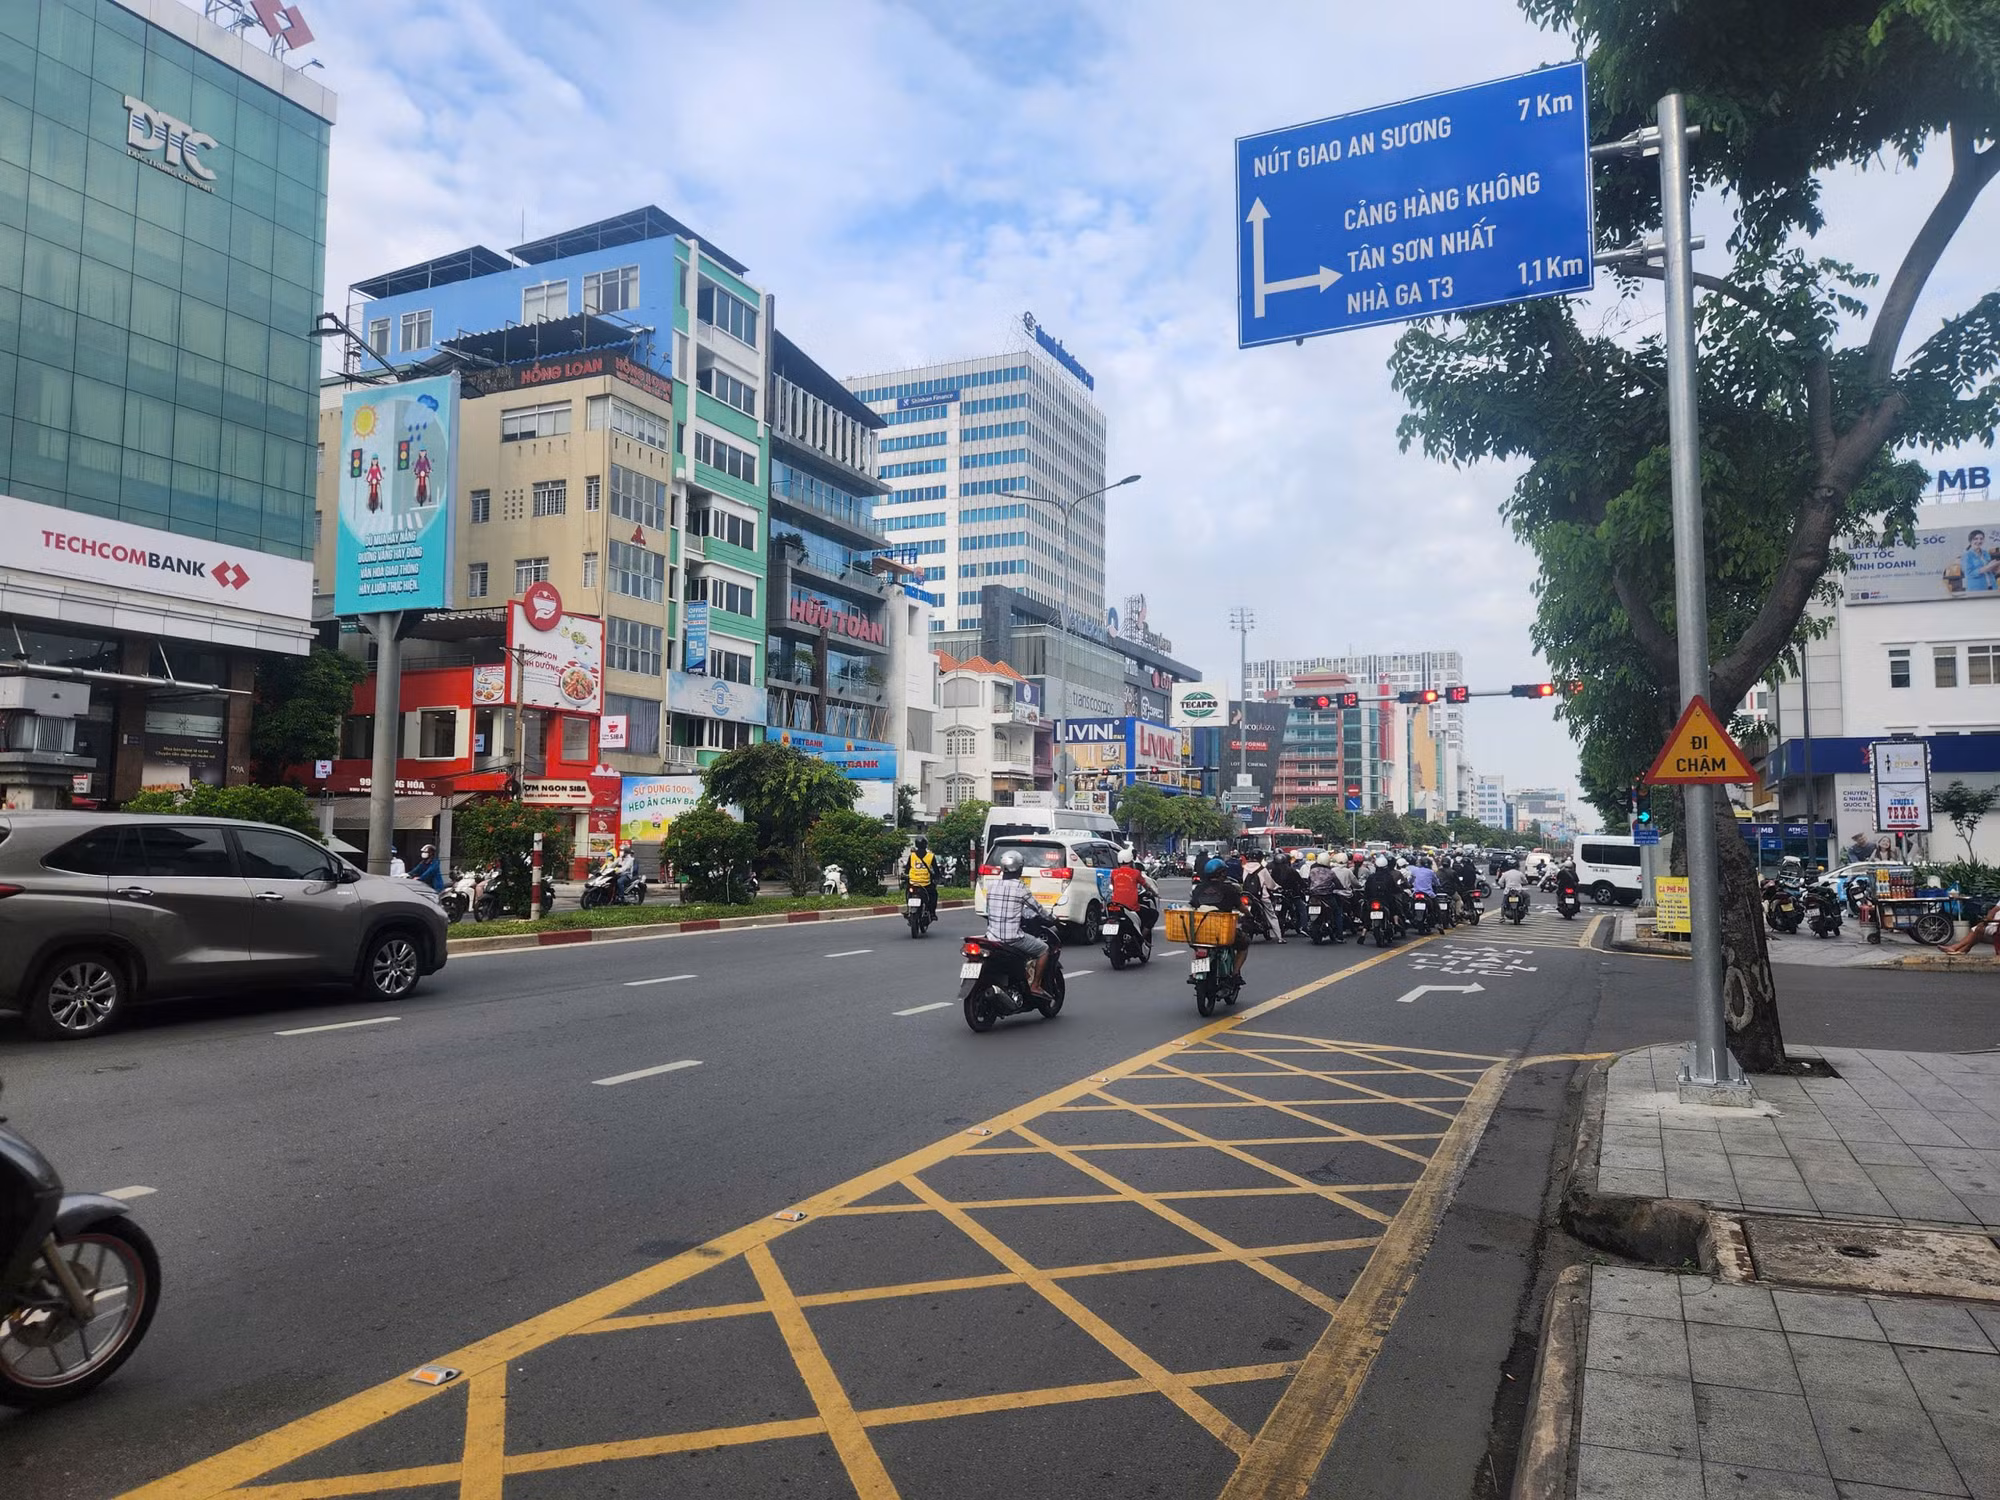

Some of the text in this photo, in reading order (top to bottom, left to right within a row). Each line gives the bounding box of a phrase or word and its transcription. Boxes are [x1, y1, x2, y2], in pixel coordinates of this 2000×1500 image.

[1518, 92, 1573, 121] 7 Km
[123, 95, 219, 181] DTC
[1254, 116, 1452, 178] NÚT GIAO AN SƯƠNG
[1344, 171, 1541, 230] CẢNG HÀNG KHÔNG
[1347, 216, 1497, 273] TÂN SƠN NHẤT
[1547, 255, 1583, 280] Km
[1347, 275, 1454, 314] NHÀ GA T3
[565, 358, 602, 376] LOAN
[1938, 466, 1991, 492] MB
[387, 532, 400, 546] HAY
[41, 530, 206, 578] TECHCOMBANK
[393, 548, 406, 561] HAY
[1877, 560, 1916, 569] DOANH
[835, 611, 883, 644] TOÀN
[1073, 690, 1114, 715] transcosmos
[1344, 694, 1357, 705] 12
[1452, 688, 1467, 700] 12
[1180, 701, 1218, 709] TECAPRO
[1056, 722, 1113, 741] LIVINI
[792, 737, 823, 747] VIETBANK
[1690, 736, 1707, 750] ĐI
[1676, 754, 1726, 775] CHẬM
[647, 785, 671, 796] DỤNG
[672, 785, 694, 794] 100%
[629, 801, 645, 812] HEO
[647, 797, 658, 807] ĂN
[660, 798, 682, 806] CHAY
[1887, 807, 1919, 819] TEXAS
